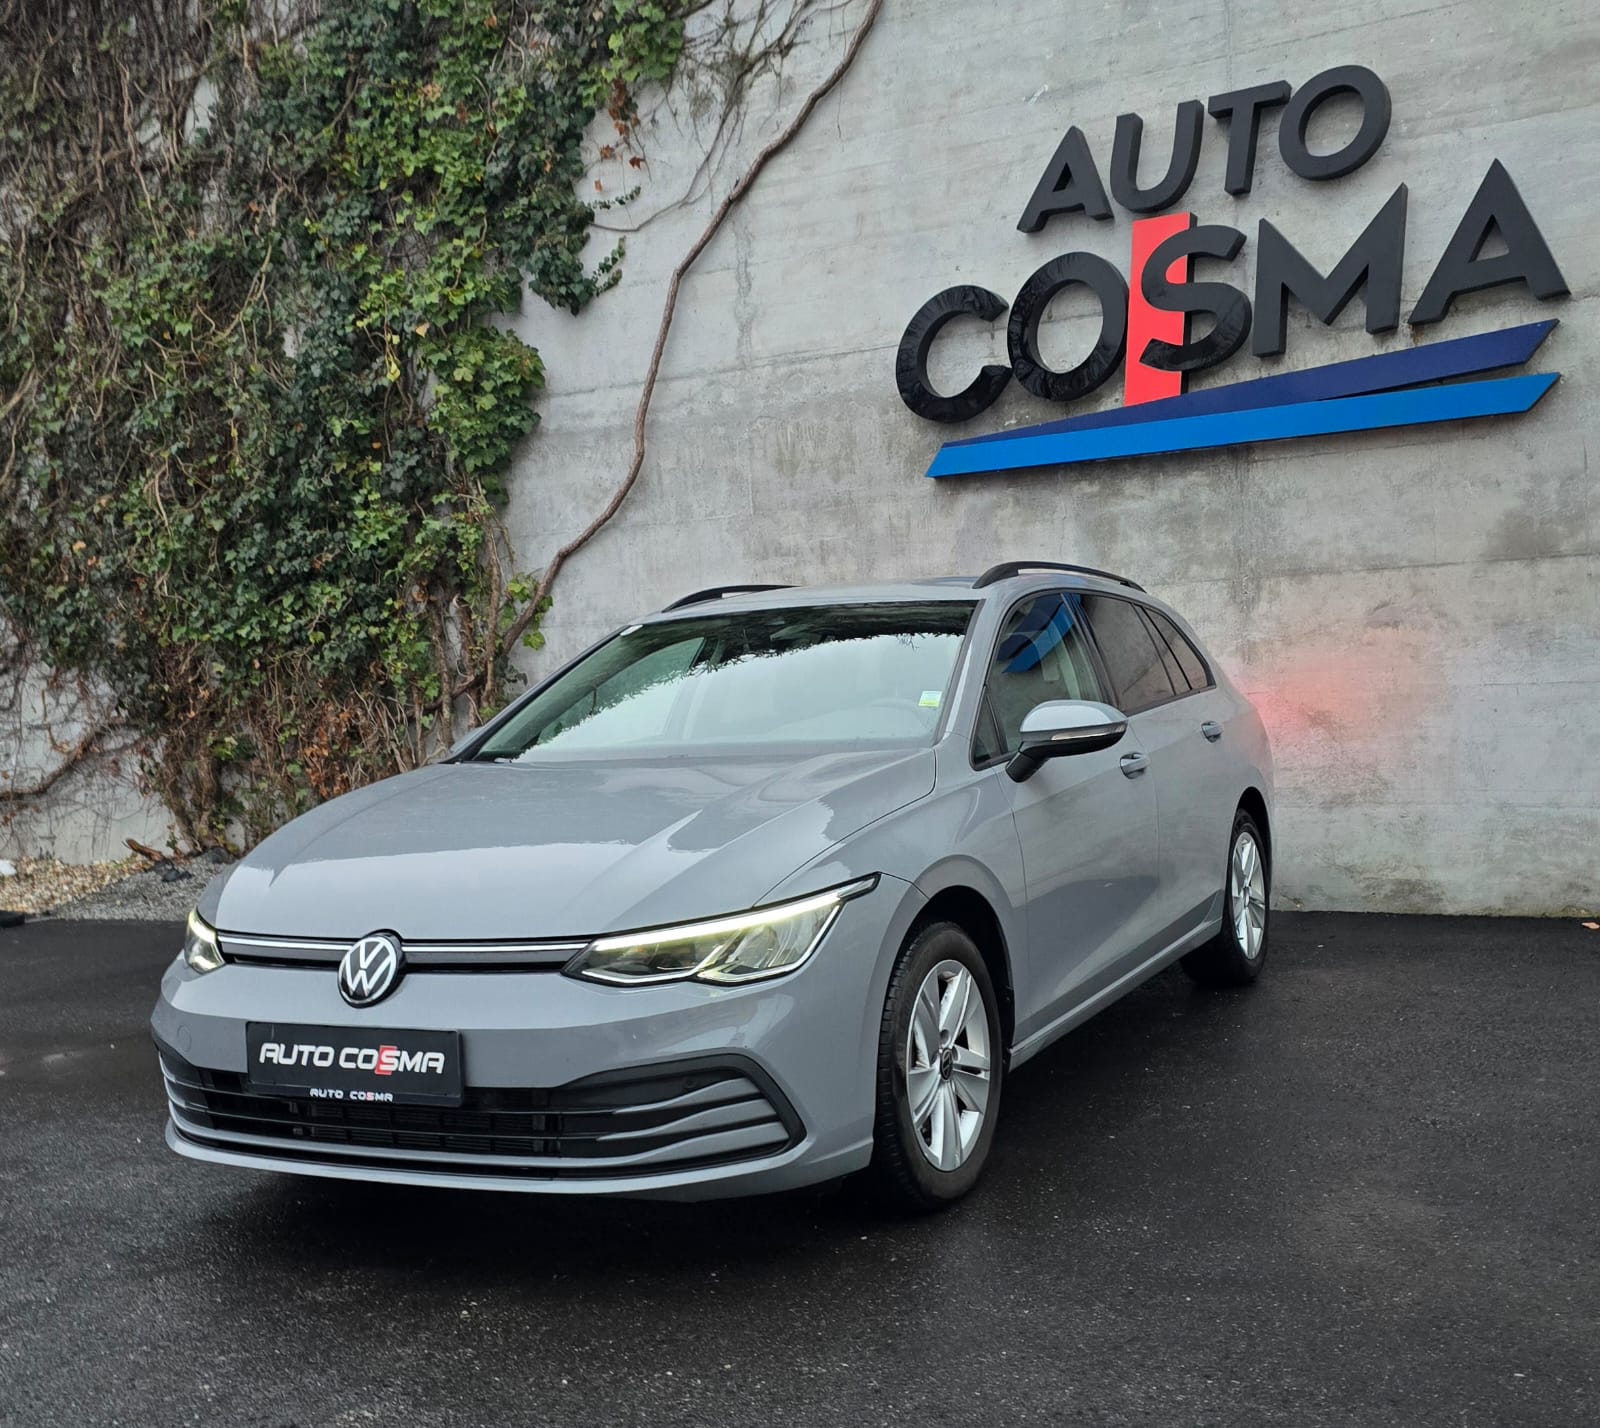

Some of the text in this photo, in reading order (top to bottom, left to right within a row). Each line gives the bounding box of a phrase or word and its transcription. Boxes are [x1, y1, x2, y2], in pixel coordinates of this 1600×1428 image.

[1016, 64, 1392, 233] AUTO
[895, 158, 1572, 424] COSMA
[338, 936, 397, 1004] VW
[259, 1042, 445, 1074] AUTO COSMA
[309, 1087, 394, 1102] AUTO COSMA
